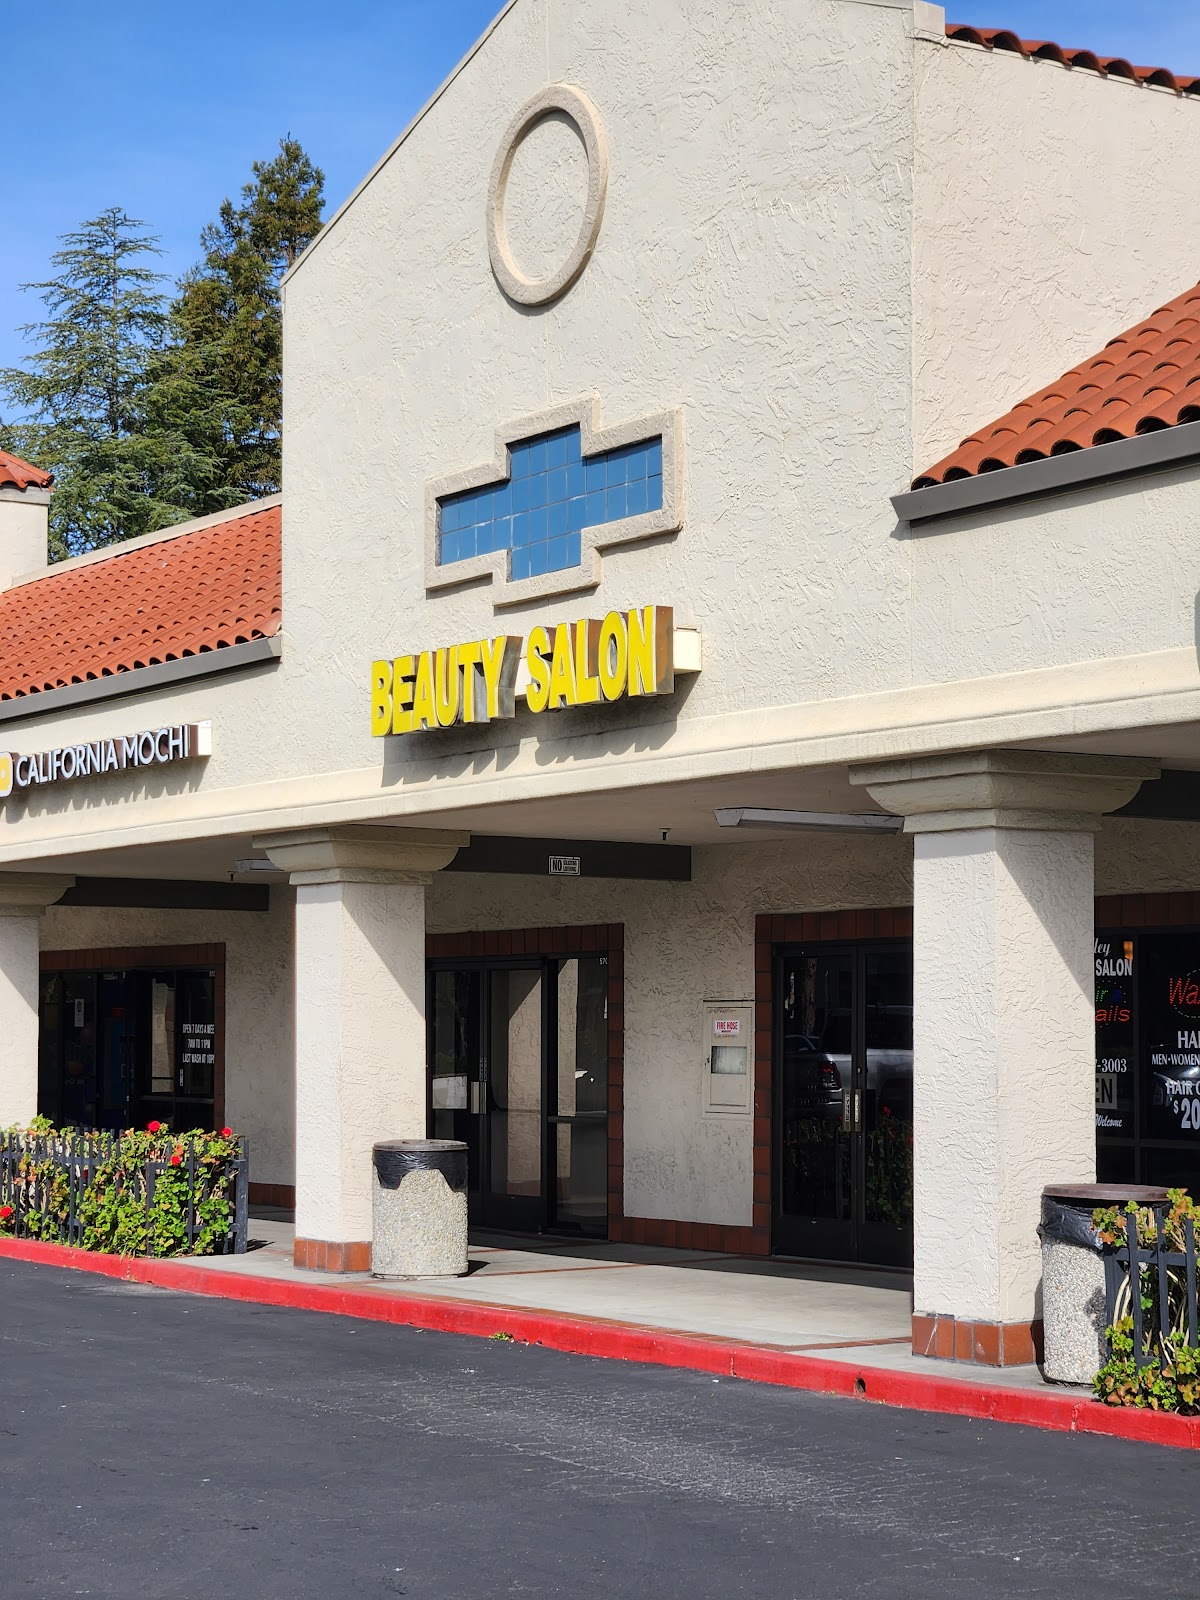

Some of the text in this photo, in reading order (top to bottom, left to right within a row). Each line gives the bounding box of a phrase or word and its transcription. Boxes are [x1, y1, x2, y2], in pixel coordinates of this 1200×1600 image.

[371, 605, 659, 737] BEAUTY SALON
[16, 724, 190, 787] CALIFORNIA MOCHI
[552, 859, 563, 872] NO
[1095, 958, 1133, 976] SALON
[716, 1021, 738, 1030] FIRE HOSE
[1165, 1080, 1193, 1096] HAIR
[1096, 1113, 1123, 1127] Welcome
